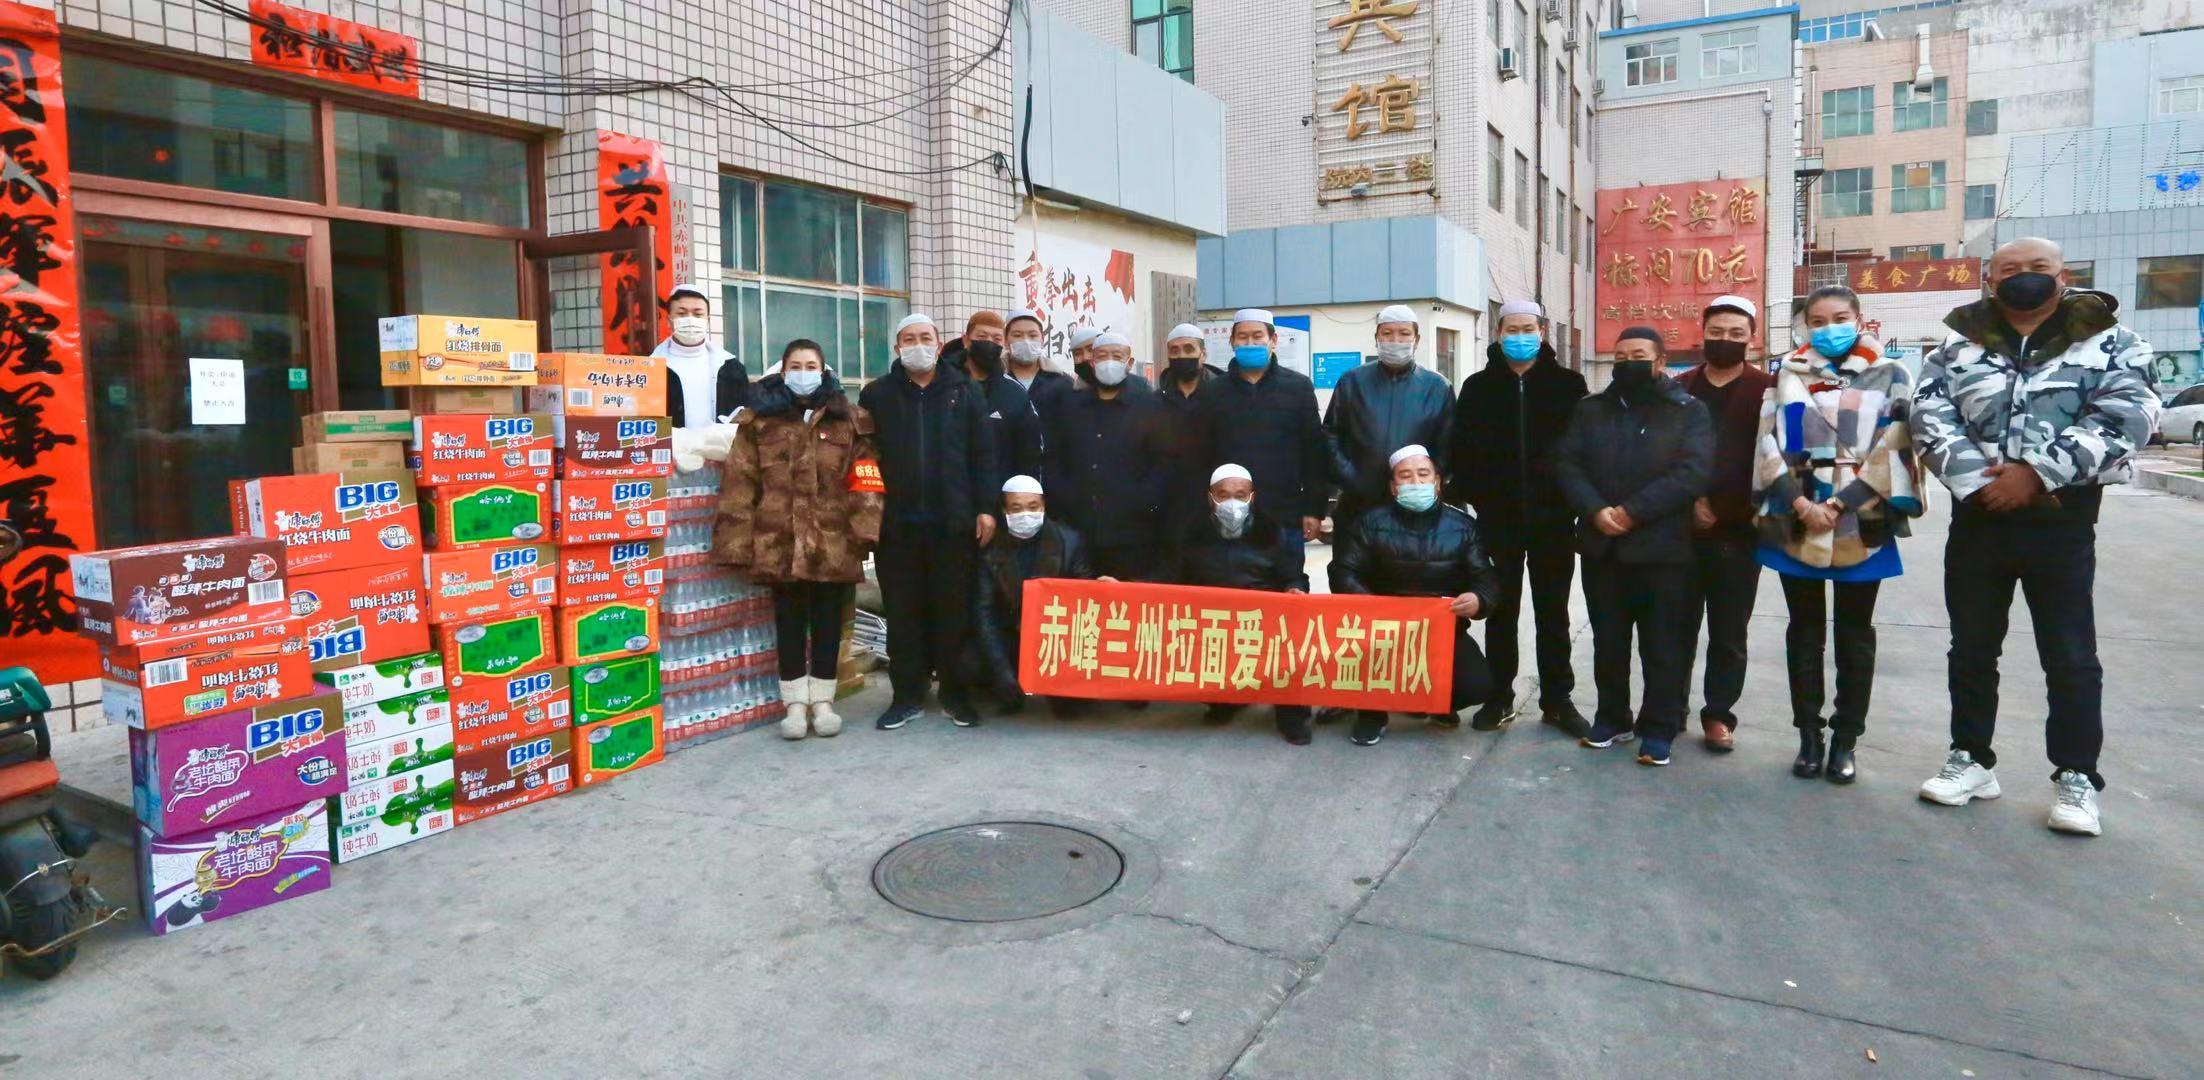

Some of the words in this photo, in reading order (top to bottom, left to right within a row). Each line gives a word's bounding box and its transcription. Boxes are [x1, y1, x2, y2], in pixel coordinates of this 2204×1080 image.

[1602, 186, 1759, 236] 广安宾馆
[1602, 244, 1758, 288] 标间70元
[1858, 263, 1971, 290] 美食广场
[488, 418, 533, 438] BIG
[620, 421, 656, 438] BIG
[433, 448, 486, 460] 红烧牛肉面
[339, 482, 400, 510] BIG
[615, 482, 651, 500] BIG
[279, 528, 350, 547] 红烧牛肉面
[495, 548, 537, 570] BIG
[612, 543, 649, 562] BIG
[171, 576, 246, 598] 酸辣牛肉面
[1038, 595, 1432, 695] 赤峰兰州拉面爱心公益团队
[201, 662, 279, 687] 红烧牛肉面
[510, 673, 552, 699] BIG
[251, 710, 323, 749] BIG
[510, 739, 551, 766] BIG
[188, 757, 240, 779] 老坛酸菜
[194, 768, 235, 787] 牛肉面
[214, 841, 278, 869] 老坛酸菜
[221, 856, 271, 879] 牛肉面
